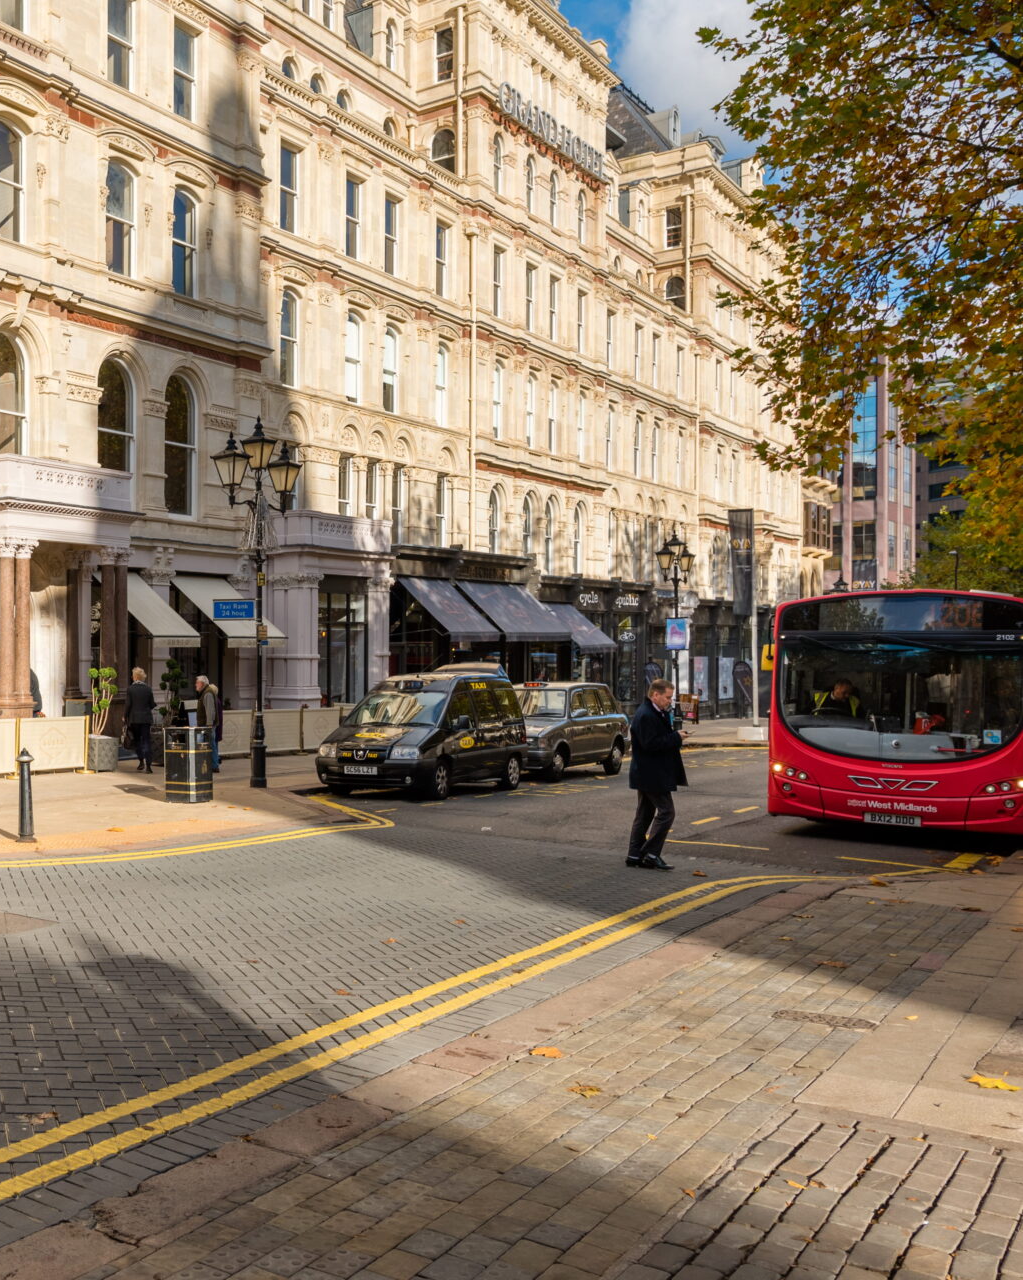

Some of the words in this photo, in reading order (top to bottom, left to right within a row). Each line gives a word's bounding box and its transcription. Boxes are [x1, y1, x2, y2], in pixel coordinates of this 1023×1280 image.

[579, 591, 599, 606] cycle
[470, 682, 487, 690] TAXI
[867, 800, 891, 810] West
[893, 802, 937, 813] Midlands
[870, 813, 893, 823] BX12
